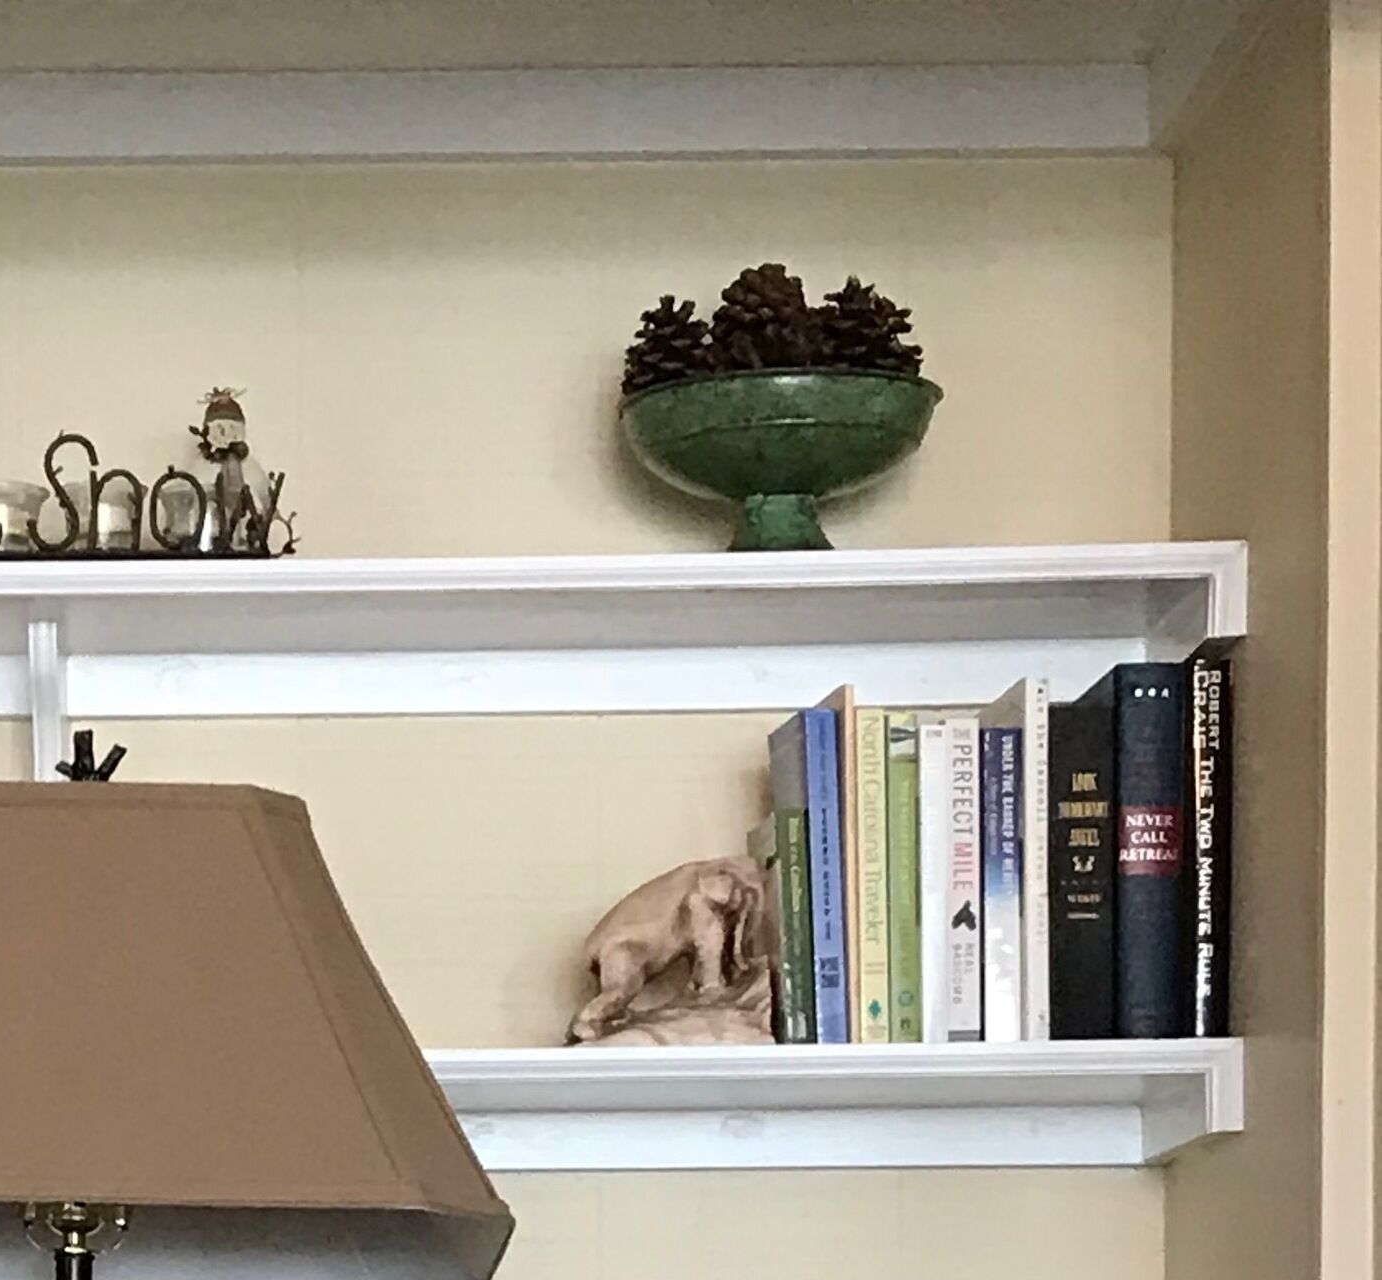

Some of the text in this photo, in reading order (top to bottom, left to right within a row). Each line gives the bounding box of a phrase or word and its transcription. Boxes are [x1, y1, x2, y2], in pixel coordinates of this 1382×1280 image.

[862, 715, 881, 774] North
[1208, 669, 1221, 751] ROBERT
[862, 779, 882, 864] Carolina
[952, 743, 974, 836] PERFECT
[1125, 813, 1174, 828] NEVER
[952, 841, 974, 892] MILE
[1129, 830, 1168, 844] CALL
[864, 869, 884, 945] Traveler
[1196, 756, 1215, 998] THE TWO MINUTE RULE
